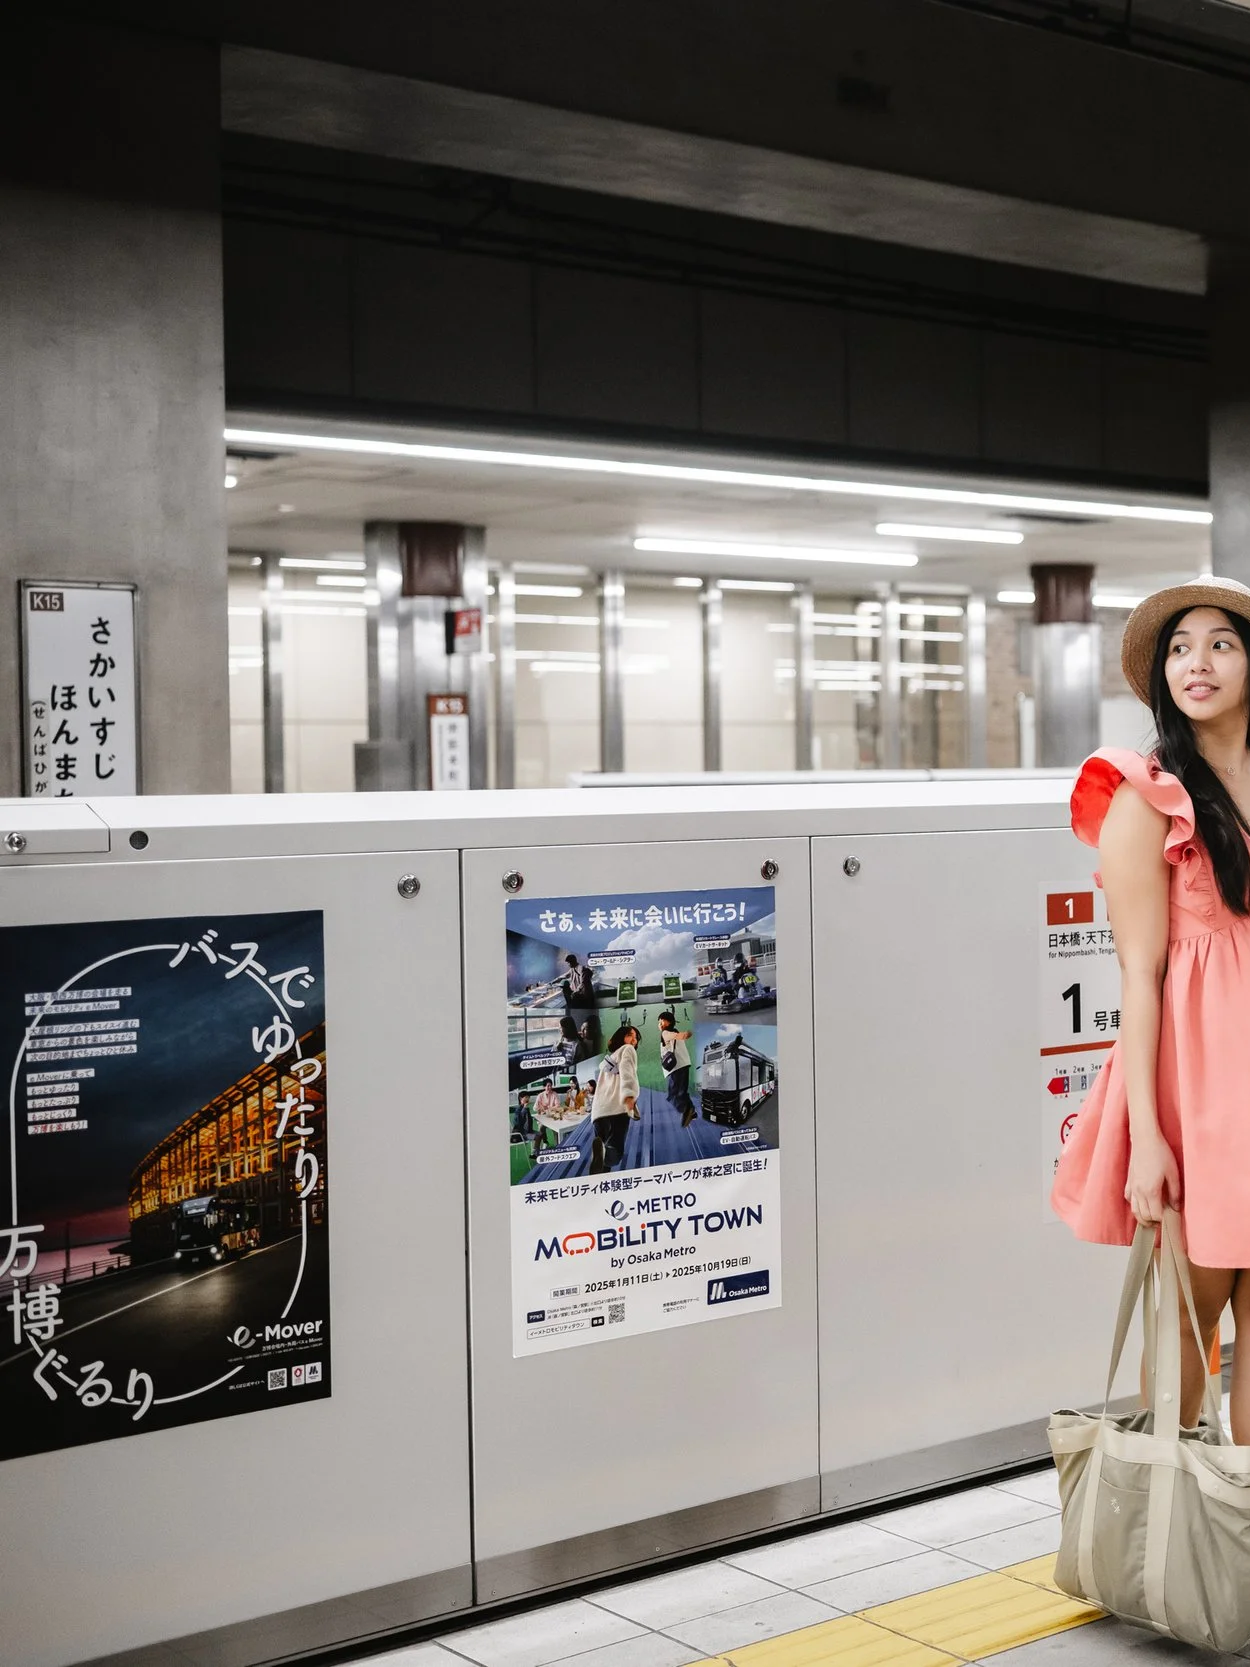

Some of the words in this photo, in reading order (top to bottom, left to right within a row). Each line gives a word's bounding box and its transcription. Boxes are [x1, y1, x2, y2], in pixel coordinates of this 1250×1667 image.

[33, 593, 60, 610] K15
[89, 616, 116, 779] さかいすじ
[51, 684, 78, 797] ほんま
[1064, 898, 1074, 919] 1
[1058, 948, 1098, 958] Nippombashi,
[525, 1158, 767, 1205] 未来モビリティ体験型テーマパークが森之宮に誕生！
[688, 1204, 763, 1236] TOWN
[611, 1257, 625, 1268] by
[628, 1250, 662, 1266] Osaka
[664, 1245, 696, 1259] Metro
[728, 1287, 748, 1297] Osaka
[748, 1284, 767, 1293] Metro
